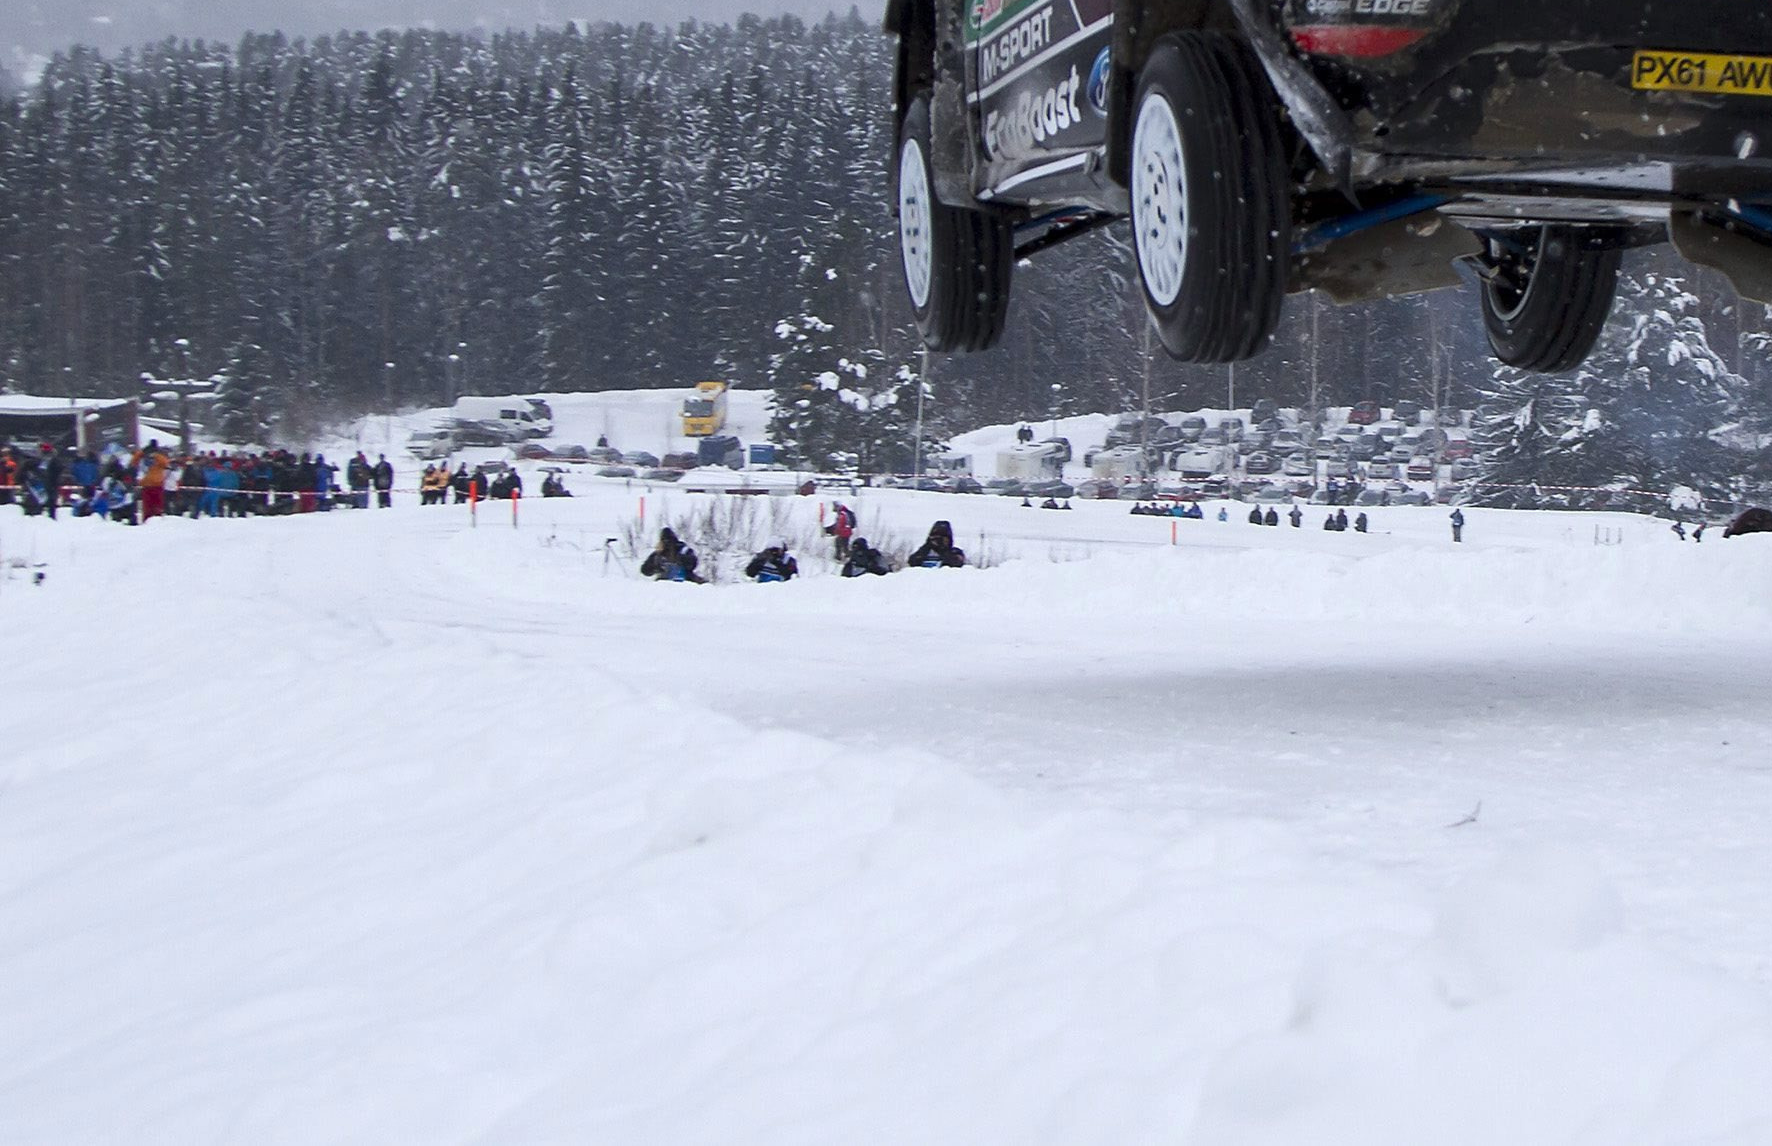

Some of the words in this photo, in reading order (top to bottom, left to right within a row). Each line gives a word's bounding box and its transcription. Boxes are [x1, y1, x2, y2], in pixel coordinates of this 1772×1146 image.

[982, 6, 1053, 82] M-SPORT
[1636, 56, 1707, 86] PX61
[985, 63, 1081, 159] EcoBoost
